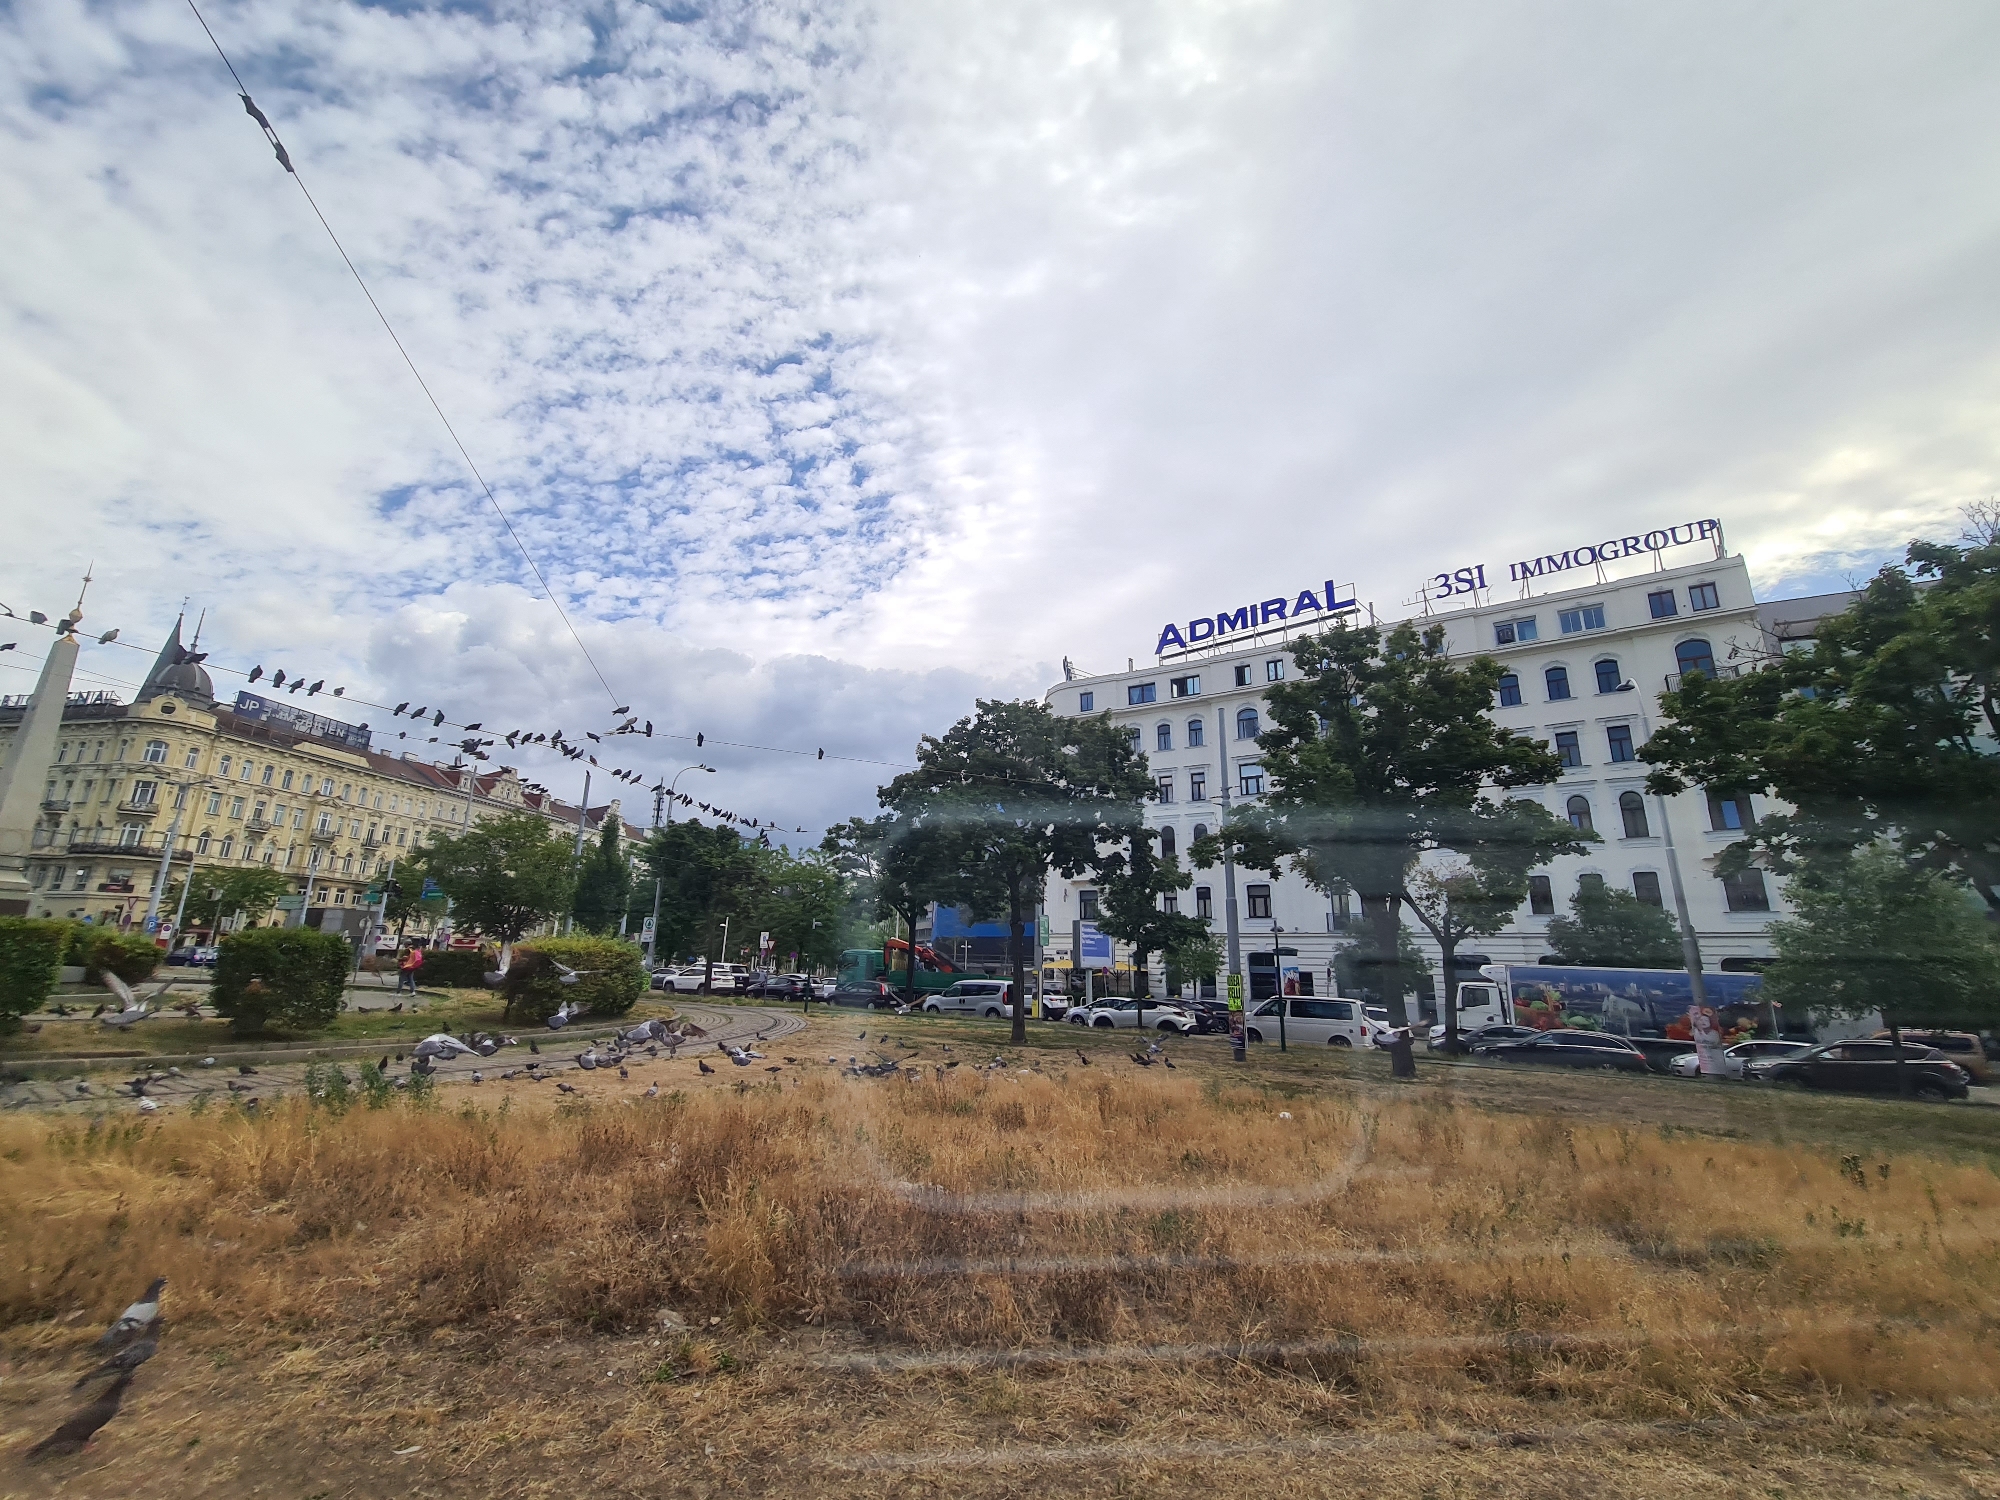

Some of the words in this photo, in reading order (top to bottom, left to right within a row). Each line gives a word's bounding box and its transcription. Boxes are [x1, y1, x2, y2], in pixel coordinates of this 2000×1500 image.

[1434, 564, 1488, 599] 3SI
[1509, 518, 1718, 582] IMMOGROUP
[1155, 579, 1356, 655] ADMIRAL
[239, 699, 260, 711] JP
